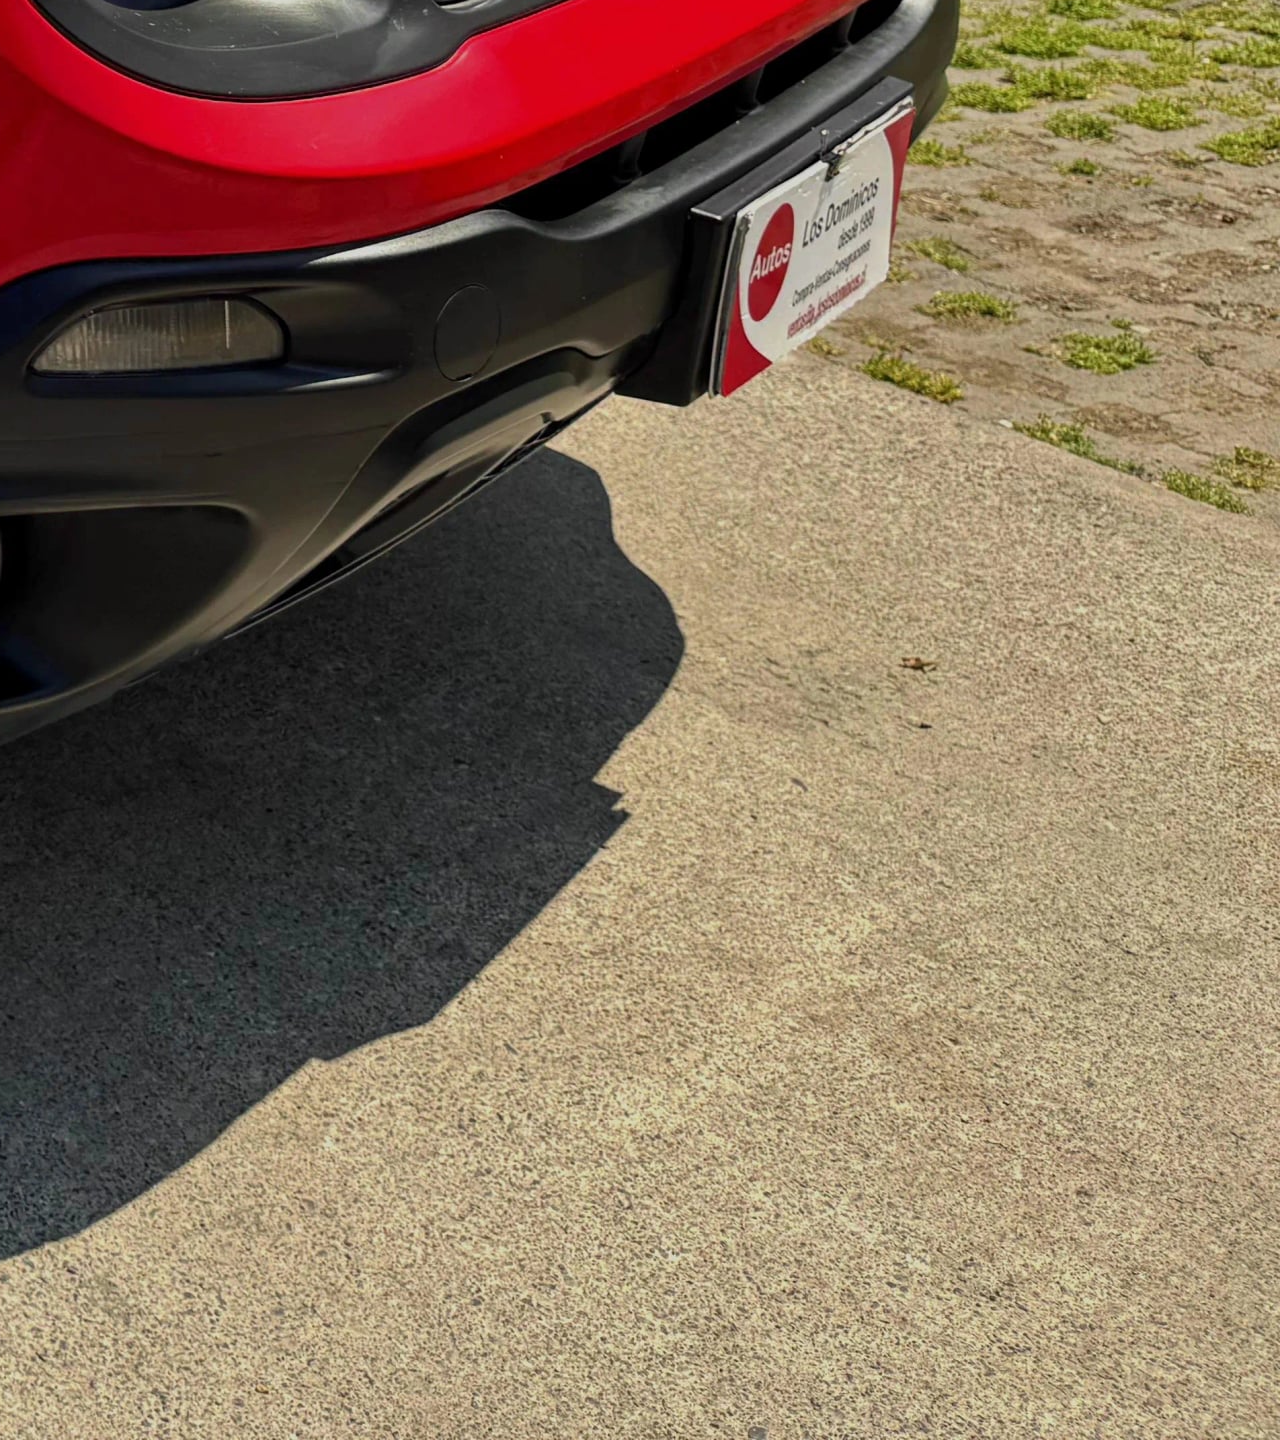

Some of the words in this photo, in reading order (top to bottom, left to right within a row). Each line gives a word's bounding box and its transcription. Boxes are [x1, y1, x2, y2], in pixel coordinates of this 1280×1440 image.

[802, 216, 824, 249] Los
[824, 177, 880, 233] Dominicos
[749, 242, 792, 284] Autos
